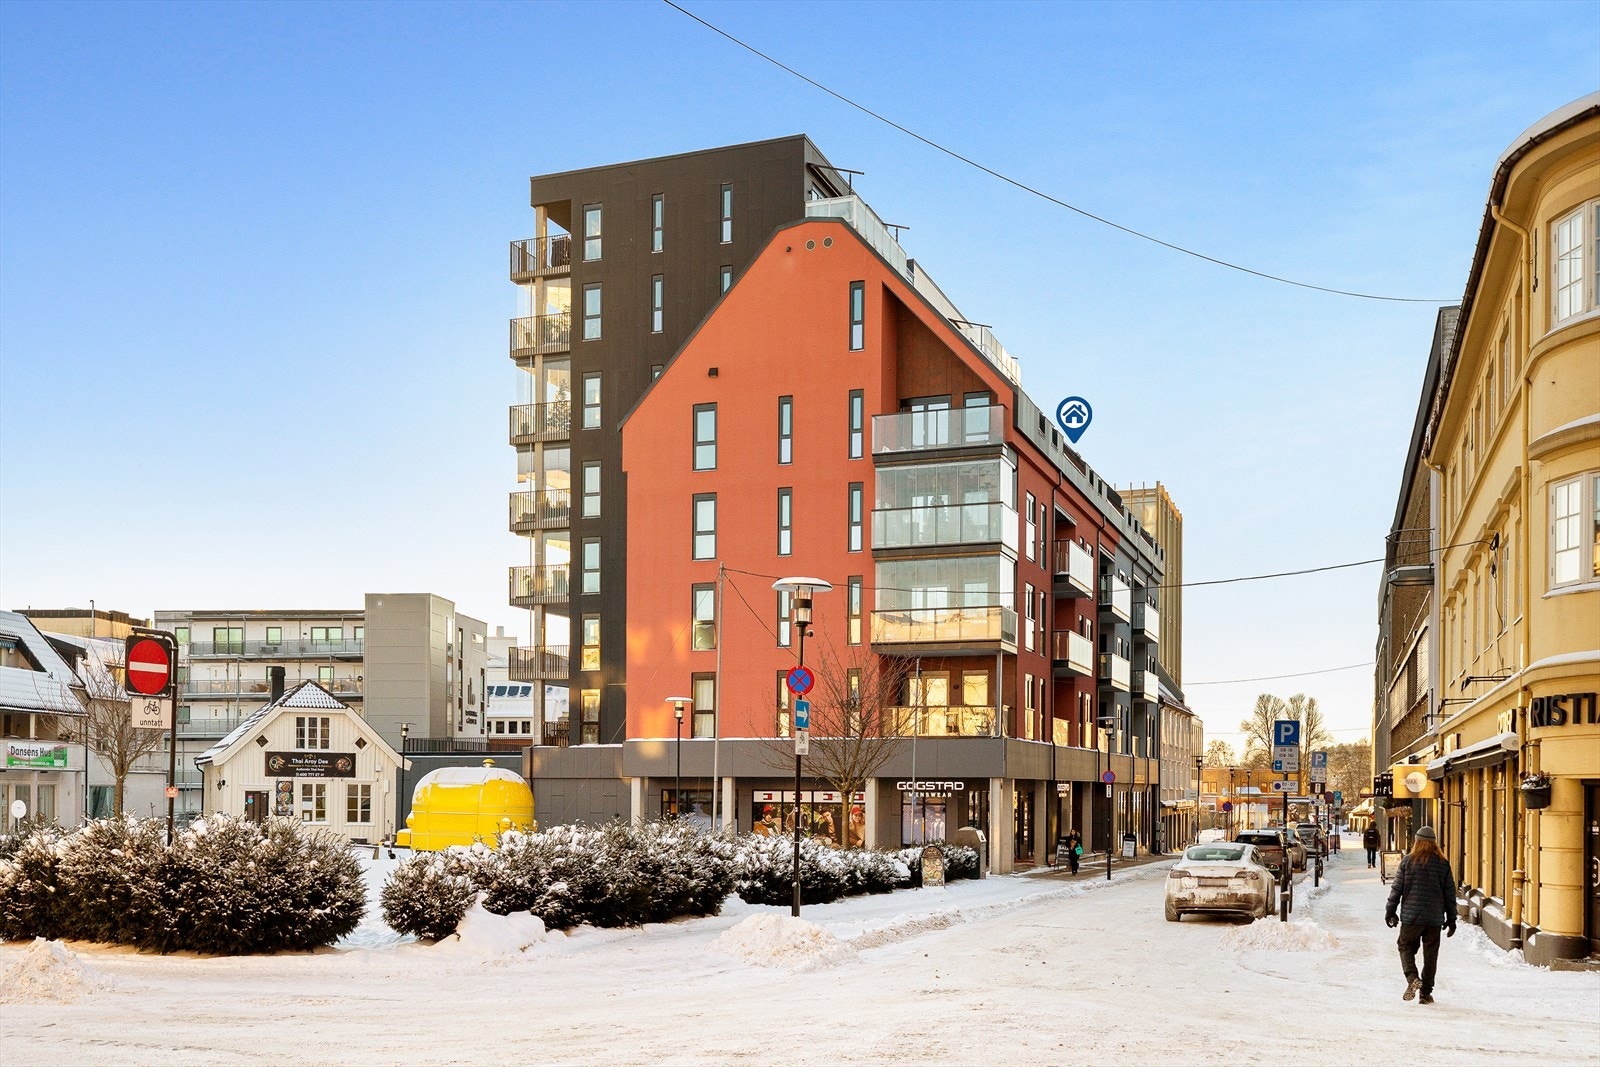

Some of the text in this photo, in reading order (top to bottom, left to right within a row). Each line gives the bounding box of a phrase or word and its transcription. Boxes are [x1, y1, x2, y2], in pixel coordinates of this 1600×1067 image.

[1530, 692, 1600, 728] RISTI
[140, 719, 163, 727] unntatt
[1281, 723, 1294, 743] P
[10, 745, 39, 757] Dansens
[40, 747, 52, 757] Hus
[1316, 753, 1324, 765] P
[896, 781, 965, 791] GOGSTAD
